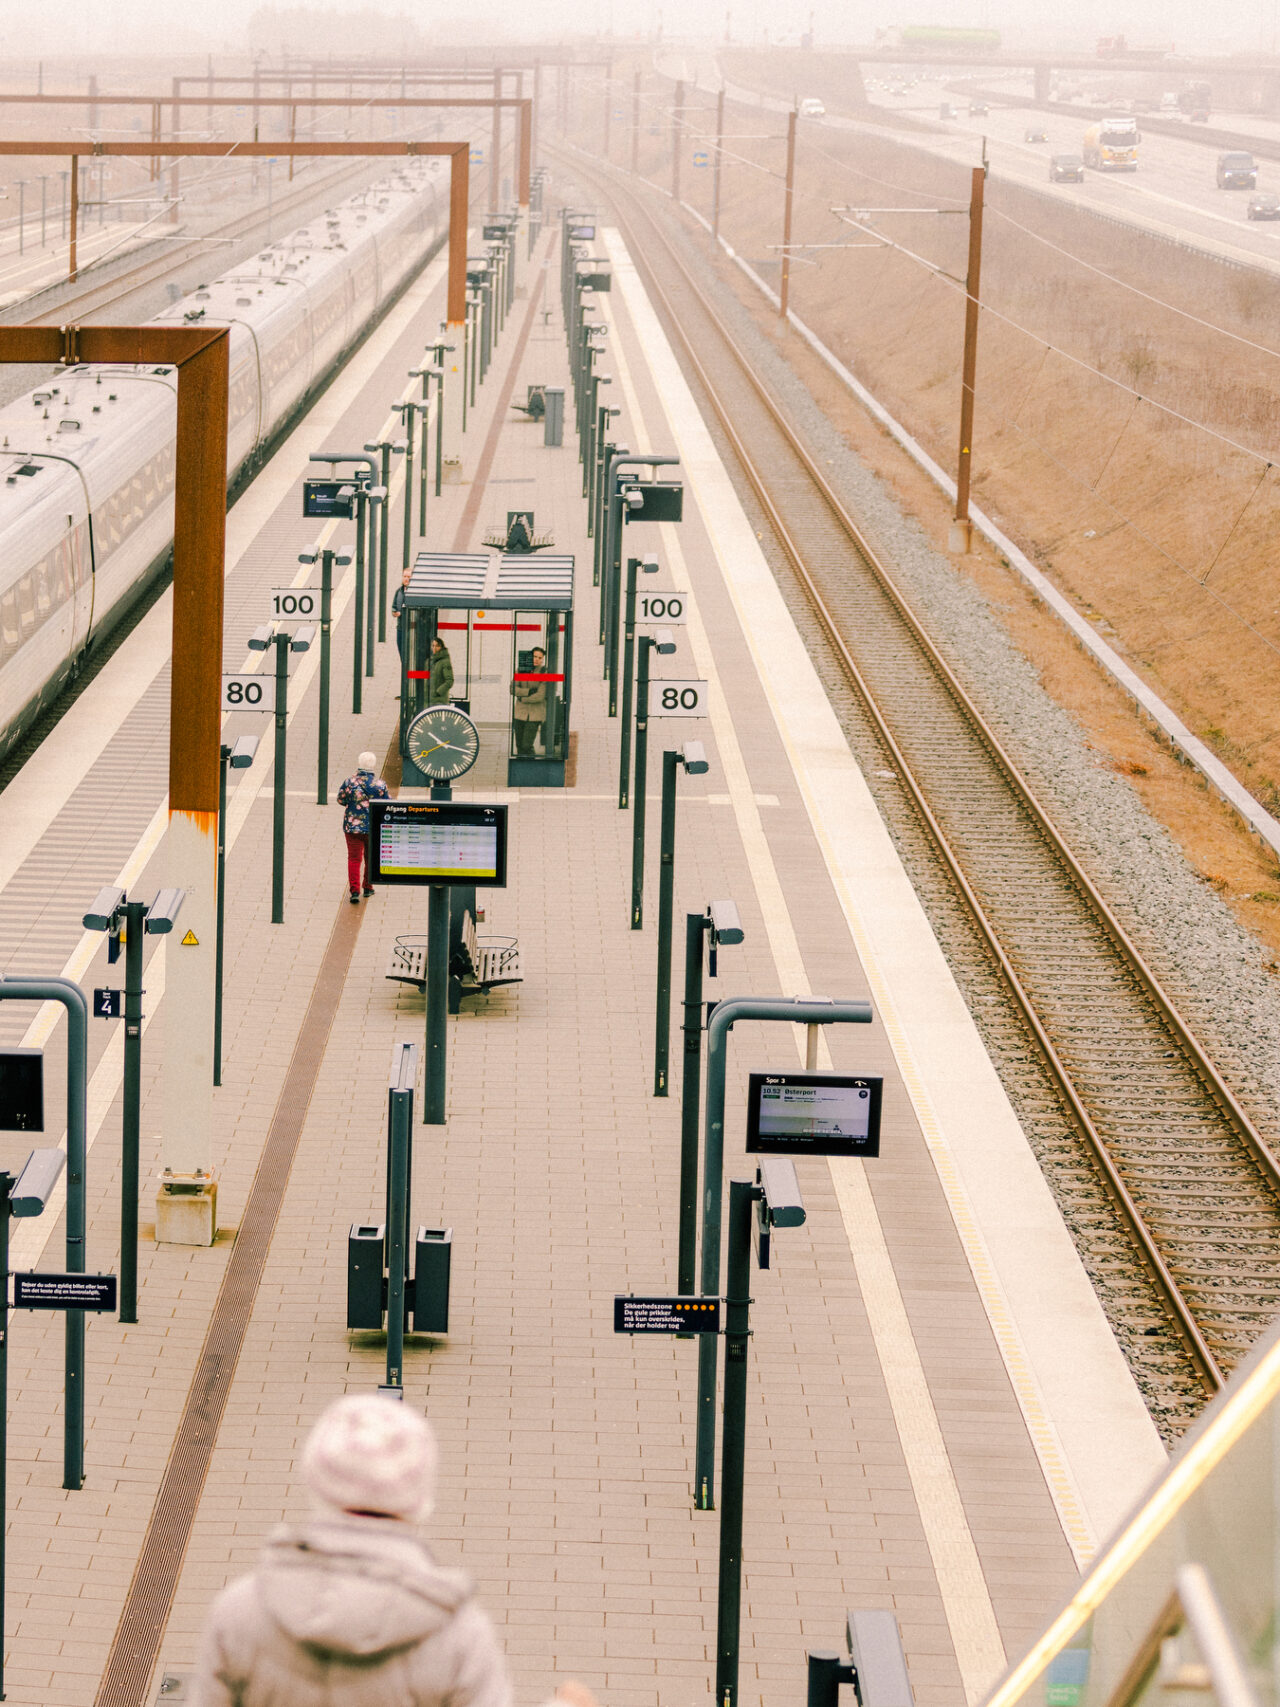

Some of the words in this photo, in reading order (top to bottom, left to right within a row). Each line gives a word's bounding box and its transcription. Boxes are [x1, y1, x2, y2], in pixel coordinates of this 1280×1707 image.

[273, 595, 314, 614] 100
[641, 598, 683, 618] 100
[227, 682, 262, 704] 80
[661, 688, 698, 710] 80
[385, 805, 407, 813] Afgang
[101, 1000, 111, 1014] 4
[784, 1088, 817, 1096] Østerport
